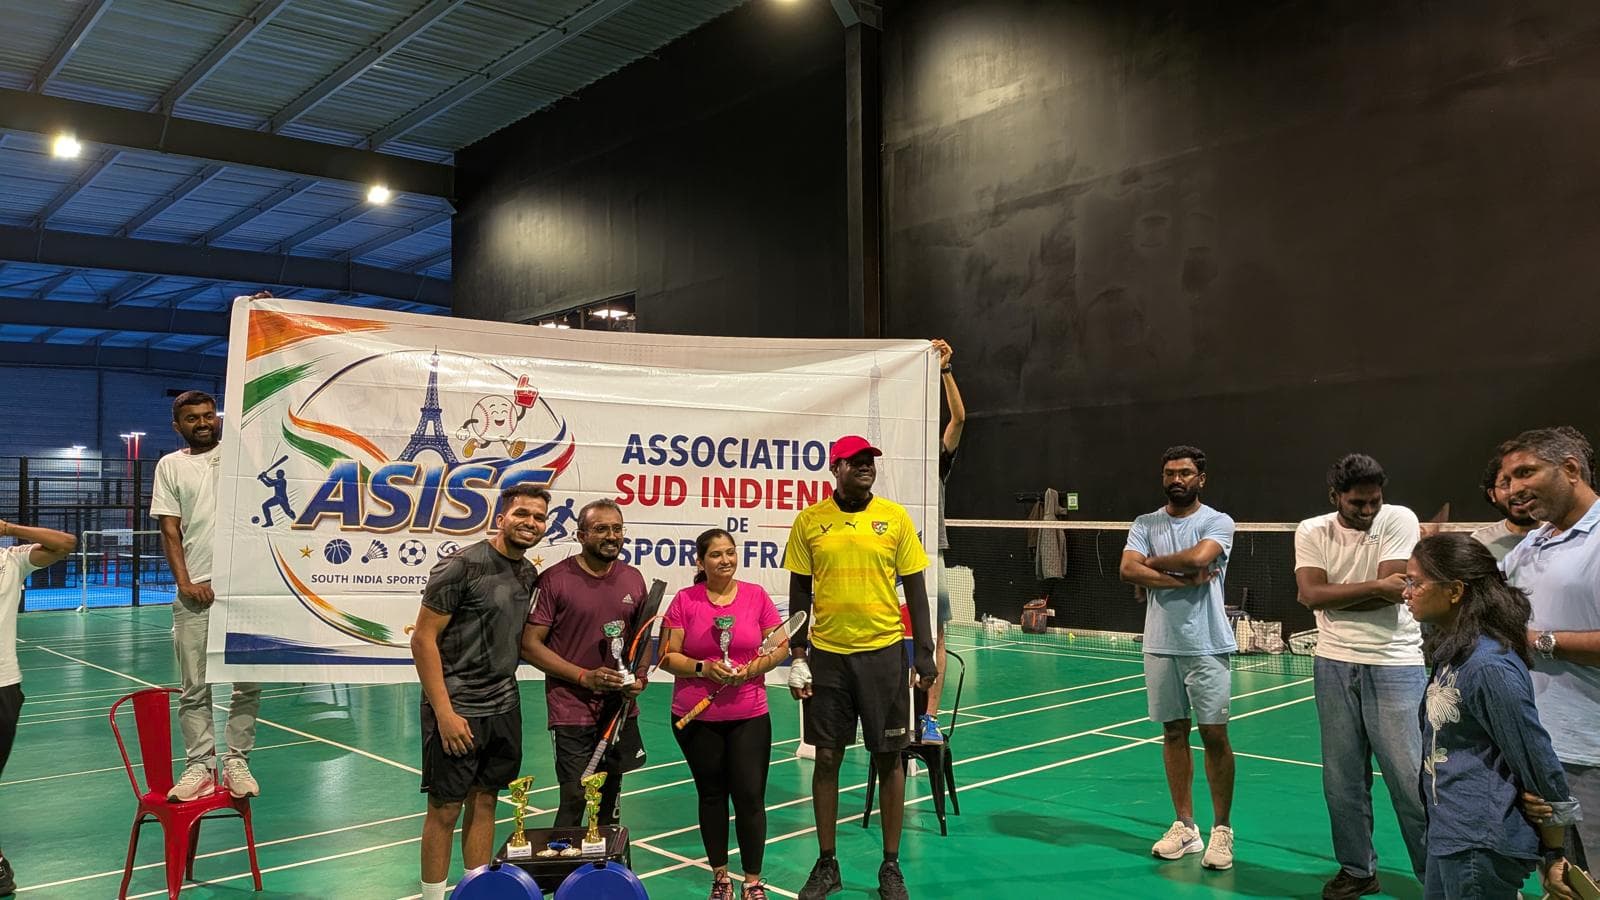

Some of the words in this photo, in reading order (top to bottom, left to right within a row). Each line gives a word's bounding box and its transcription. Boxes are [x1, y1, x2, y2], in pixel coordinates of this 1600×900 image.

[621, 433, 836, 472] ASSOCIATIO
[614, 473, 688, 507] SUD
[726, 516, 749, 533] DE
[620, 537, 697, 567] SPOR
[743, 540, 789, 569] FR
[311, 574, 349, 584] SOUTH
[353, 575, 383, 584] INDIA
[386, 575, 428, 585] SPORTS
